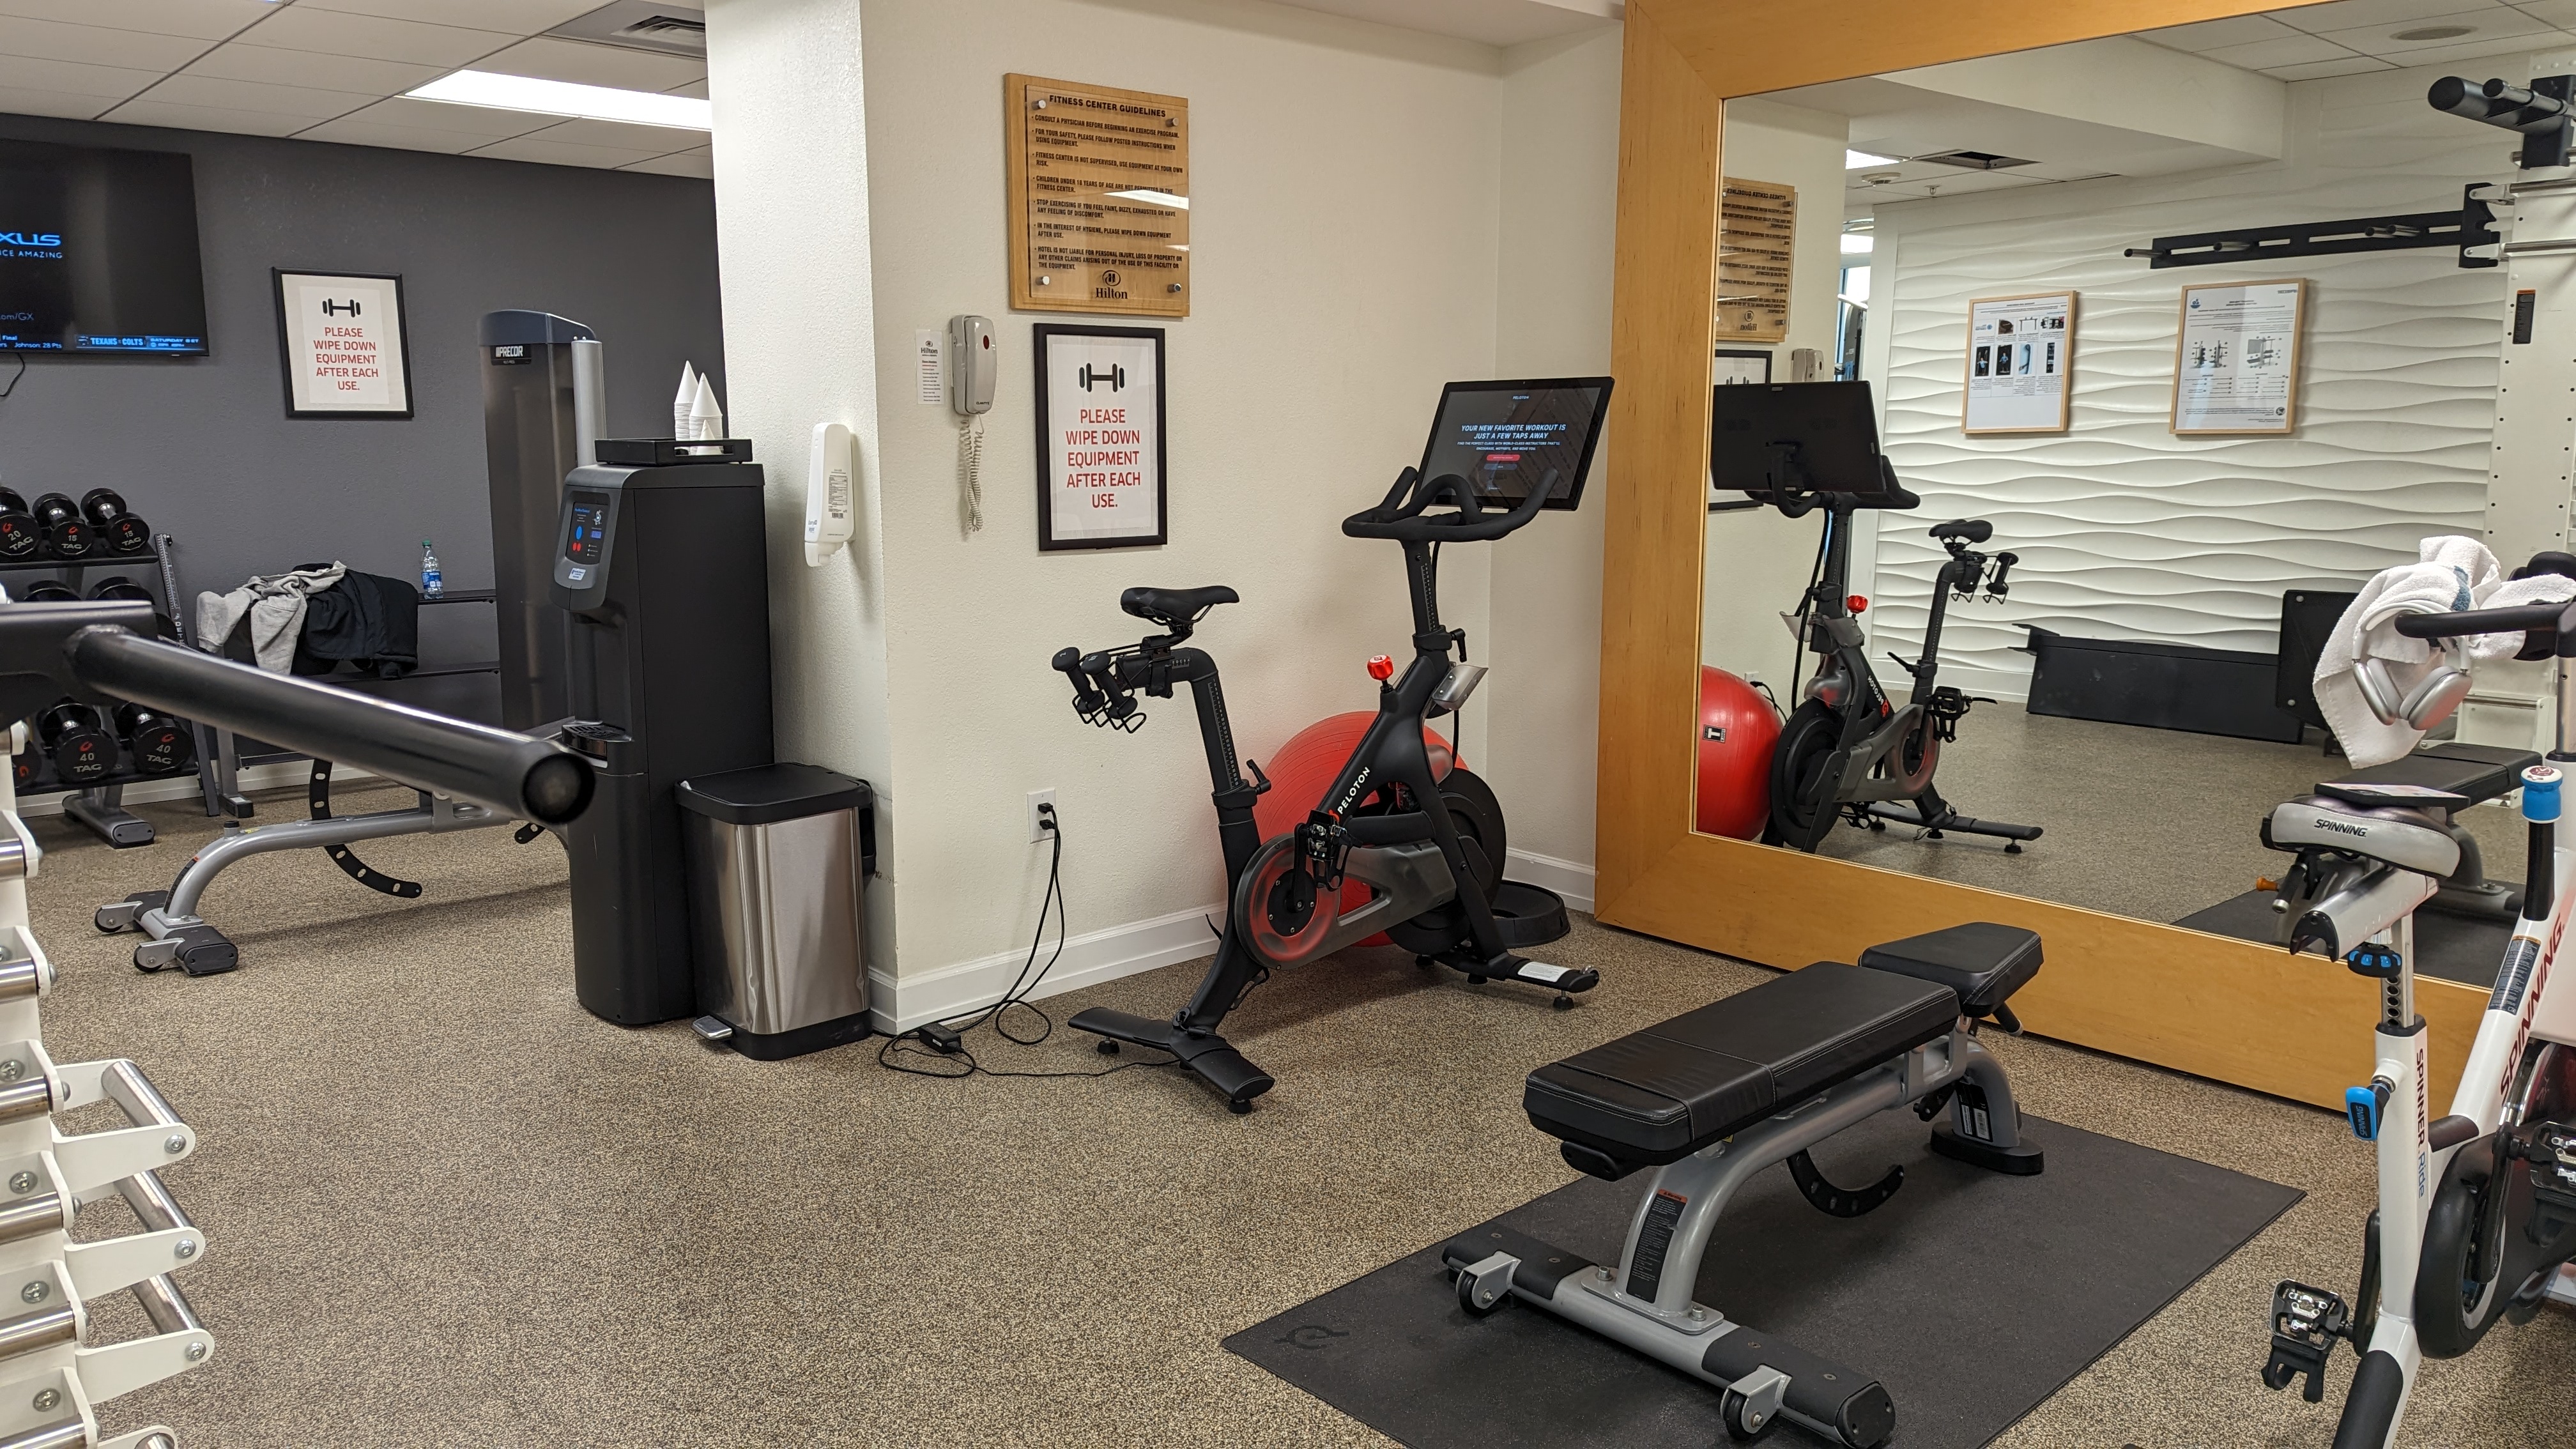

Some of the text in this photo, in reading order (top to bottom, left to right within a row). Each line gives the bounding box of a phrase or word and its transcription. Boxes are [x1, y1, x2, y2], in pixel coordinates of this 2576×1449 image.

[1049, 95, 1165, 117] FITNESS CENTER GUIDELINES
[1034, 114, 1055, 123] CONSULT
[1061, 118, 1085, 126] PHYSICIAN
[1085, 121, 1103, 129] BEFORE
[1104, 123, 1128, 132] BEGINNING
[1135, 126, 1156, 135] EXERCISE
[1157, 130, 1179, 138] PROGRAM.
[1051, 137, 1078, 147] EQUIPMENT.
[1059, 131, 1077, 140] SAFETY,
[1077, 133, 1094, 141] PLEASE
[1095, 135, 1113, 143] FOLLOW
[1131, 139, 1162, 149] INSTRUCTIONS
[1035, 151, 1054, 160] FITNESS
[1055, 153, 1073, 162] CENTER
[1089, 157, 1118, 167] SUPERVISED,
[1128, 162, 1153, 170] EQUIPMENT
[1036, 175, 1059, 183] CHILDREN
[1049, 200, 1076, 208] EXERCISING
[1104, 204, 1118, 213] FAINT,
[1119, 206, 1131, 214] DIZZY,
[1132, 207, 1156, 215] EXHAUSTED
[1074, 210, 1104, 218] DISCOMFORT.
[1082, 226, 1103, 234] HYGIENE,
[18, 250, 63, 259] AMAZING
[1095, 287, 1128, 300] Hilton
[325, 326, 363, 337] PLEASE
[313, 340, 376, 351] WIPE DOWN
[500, 346, 523, 357] PRECOR
[316, 353, 376, 365] EQUIPMENT
[316, 367, 379, 378] AFTER EACH
[337, 381, 360, 390] USE.
[1080, 409, 1126, 424] PLEASE
[1066, 429, 1140, 445] WIPE DOWN
[1068, 450, 1140, 469] EQUIPMENT
[1066, 471, 1140, 488] AFTER EACH
[1092, 493, 1118, 509] USE.
[8, 530, 21, 541] 20
[121, 537, 142, 546] TAG
[9, 536, 34, 551] TAG
[156, 745, 171, 753] 40
[80, 753, 95, 762] 40
[146, 755, 172, 765] TAG
[73, 763, 102, 772] TAG
[1337, 766, 1370, 815] PELOTON
[2313, 818, 2368, 838] SPINNING
[2501, 912, 2563, 1107] SPINNING
[2416, 1048, 2425, 1148] SPINNER
[2356, 1105, 2368, 1137] SPINNING
